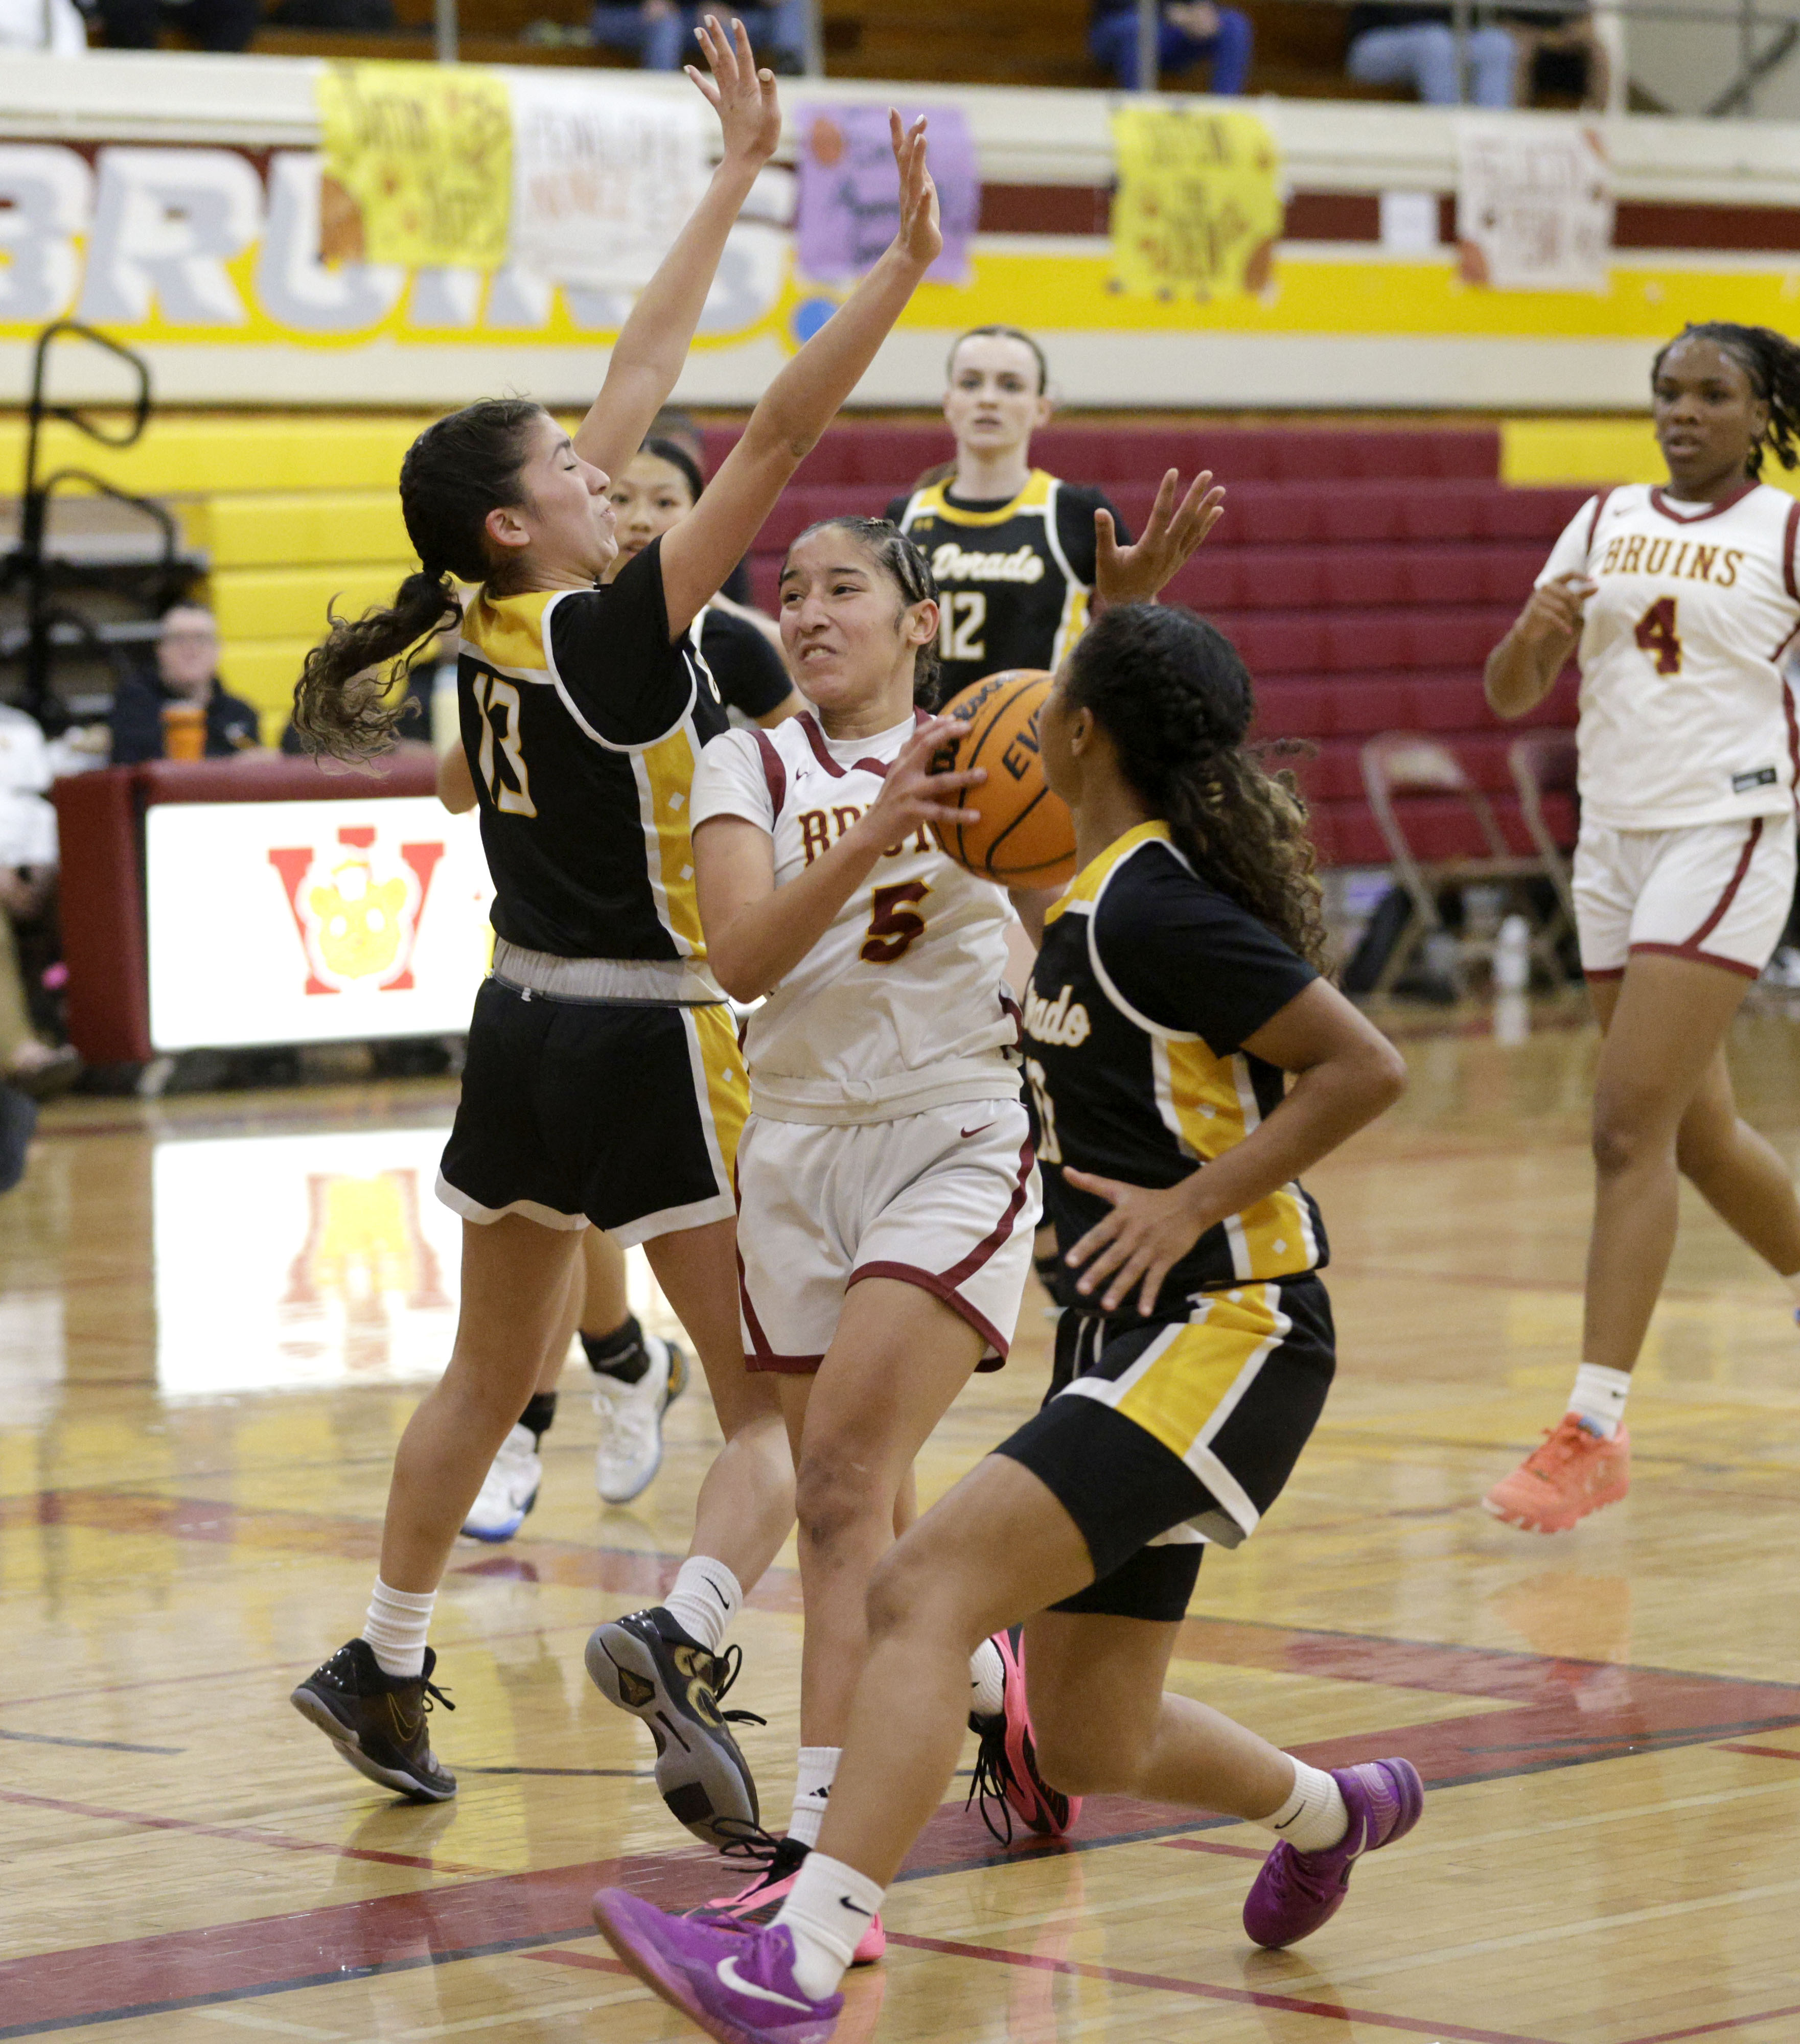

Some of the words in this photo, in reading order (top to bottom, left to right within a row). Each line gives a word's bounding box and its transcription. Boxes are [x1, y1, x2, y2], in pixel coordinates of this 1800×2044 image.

[1600, 535, 1744, 588] BRUINS
[939, 591, 987, 660] 12
[1635, 595, 1681, 676] 4
[472, 671, 538, 819] 13
[859, 878, 935, 965] 5
